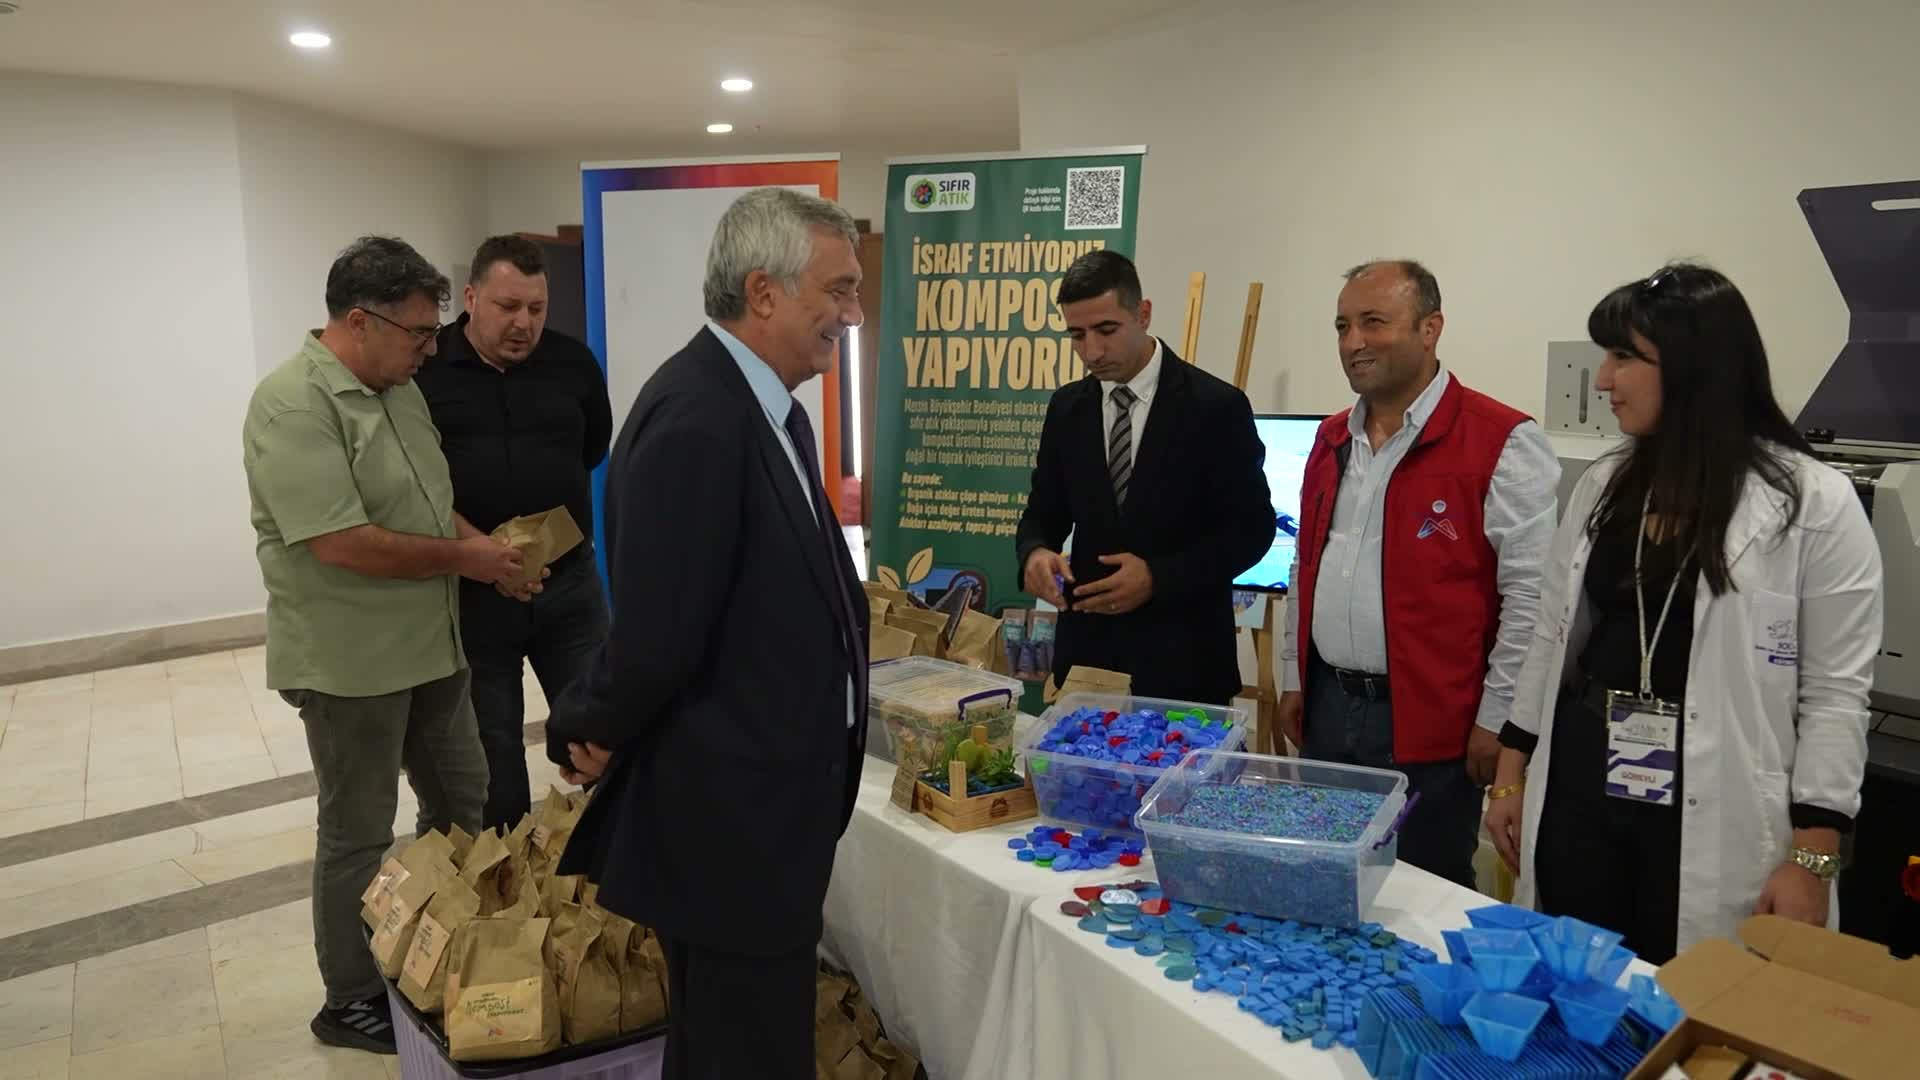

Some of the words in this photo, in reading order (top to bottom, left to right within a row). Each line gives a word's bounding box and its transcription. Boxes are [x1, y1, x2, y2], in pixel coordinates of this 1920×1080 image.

[939, 179, 970, 192] SIFIR
[939, 192, 969, 206] ATIK
[912, 236, 974, 275] İSRAF
[916, 278, 1068, 332] KOMPOS
[902, 336, 1091, 391] YAPIYORU
